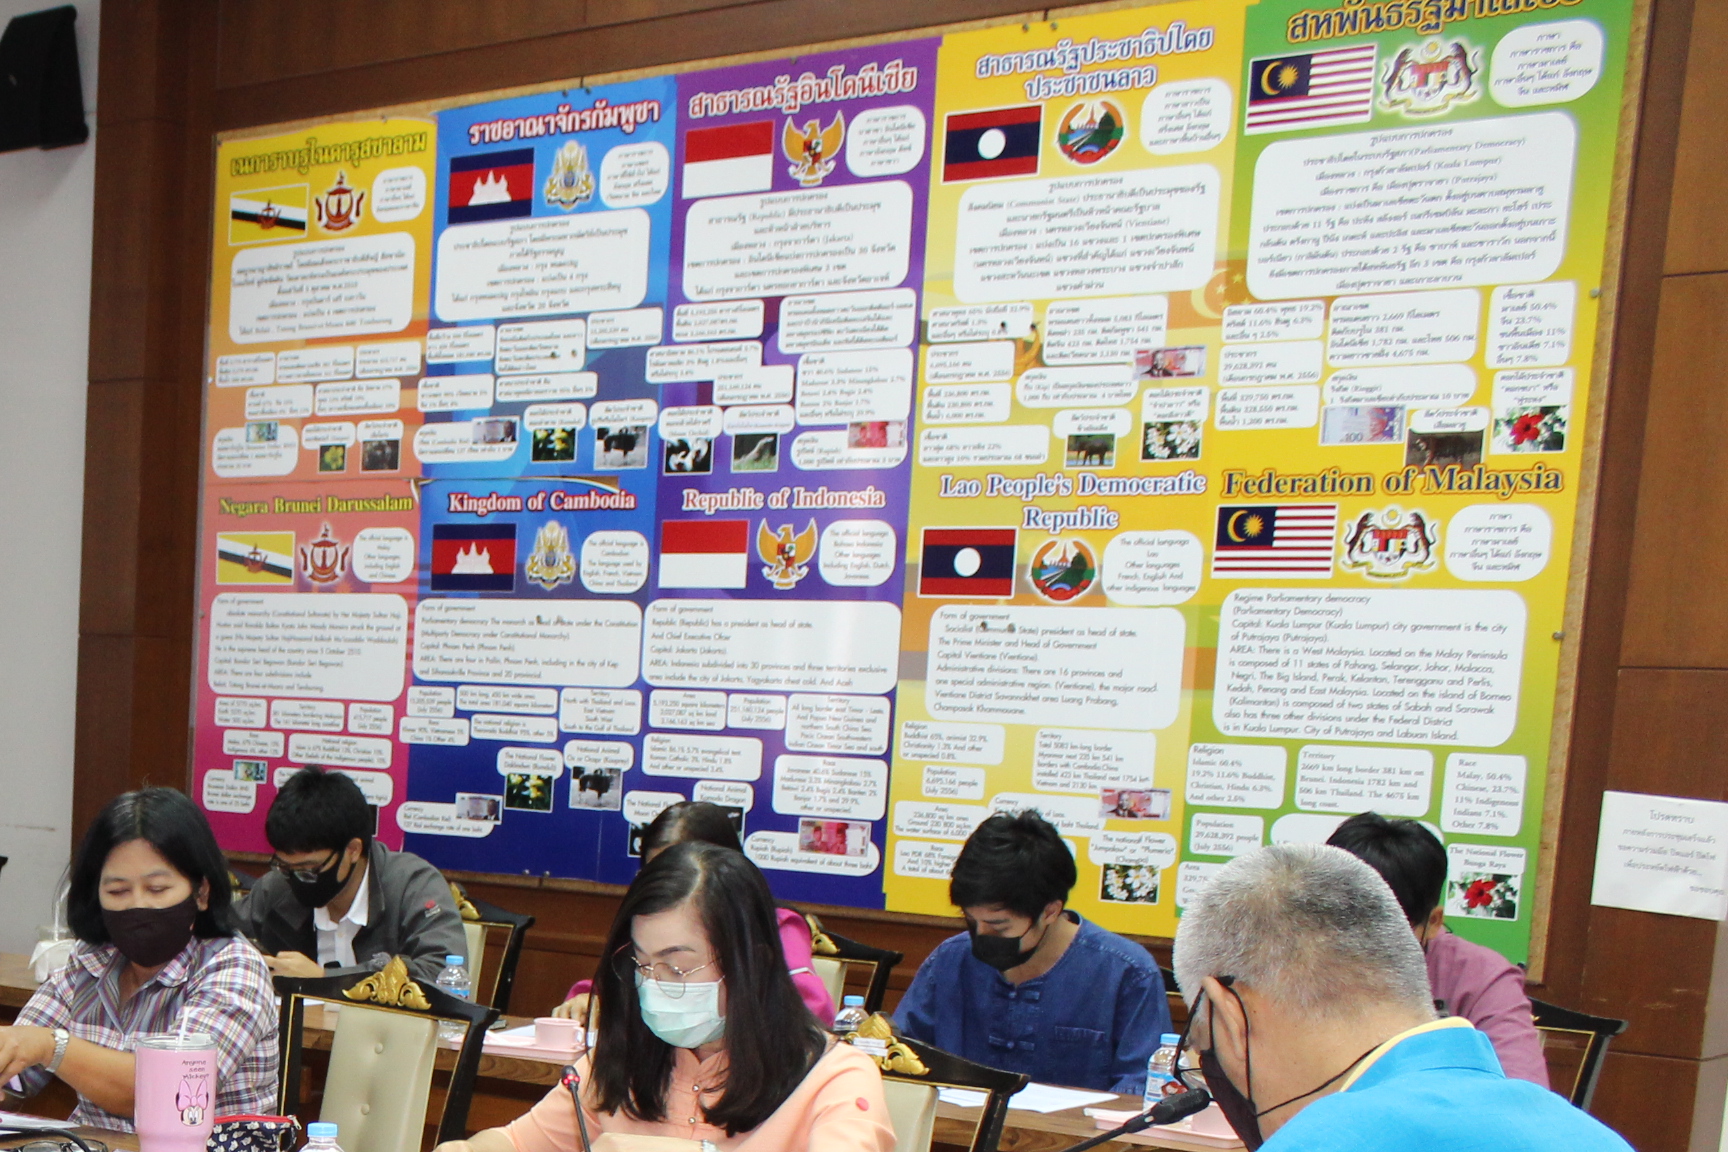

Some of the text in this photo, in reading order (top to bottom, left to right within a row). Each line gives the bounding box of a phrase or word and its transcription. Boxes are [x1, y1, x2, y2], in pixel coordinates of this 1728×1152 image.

[689, 59, 917, 117] สาธารณรัฐอินโดนีเซีย
[1025, 65, 1157, 101] ประชาชนลาว
[468, 99, 660, 146] ราชอาณาจักรกัมพูชา
[940, 475, 981, 497] Lao
[1077, 472, 1206, 497] Democratic
[1223, 463, 1564, 500] Federation of Malaysia
[220, 496, 414, 517] Negara Brunei Darussalam
[448, 490, 636, 516] Kingdom of Cambodia
[682, 485, 885, 513] Republic of Indonesia
[1023, 506, 1119, 531] Republic
[1233, 593, 1264, 604] Regime
[1324, 594, 1371, 605] democracy
[1240, 632, 1280, 643] Putrajaya
[1265, 620, 1289, 629] Kuala
[1292, 620, 1322, 631] Lumpur
[1325, 621, 1353, 632] (Kuala
[1355, 621, 1390, 632] Lumpur)
[1392, 622, 1408, 633] city
[1474, 623, 1489, 632] the
[1491, 624, 1508, 634] city
[1258, 645, 1280, 654] There
[1302, 646, 1323, 655] West
[1368, 648, 1402, 657] Located
[1418, 649, 1433, 658] the
[1435, 649, 1463, 660] Malay
[1466, 650, 1508, 659] Peninsula
